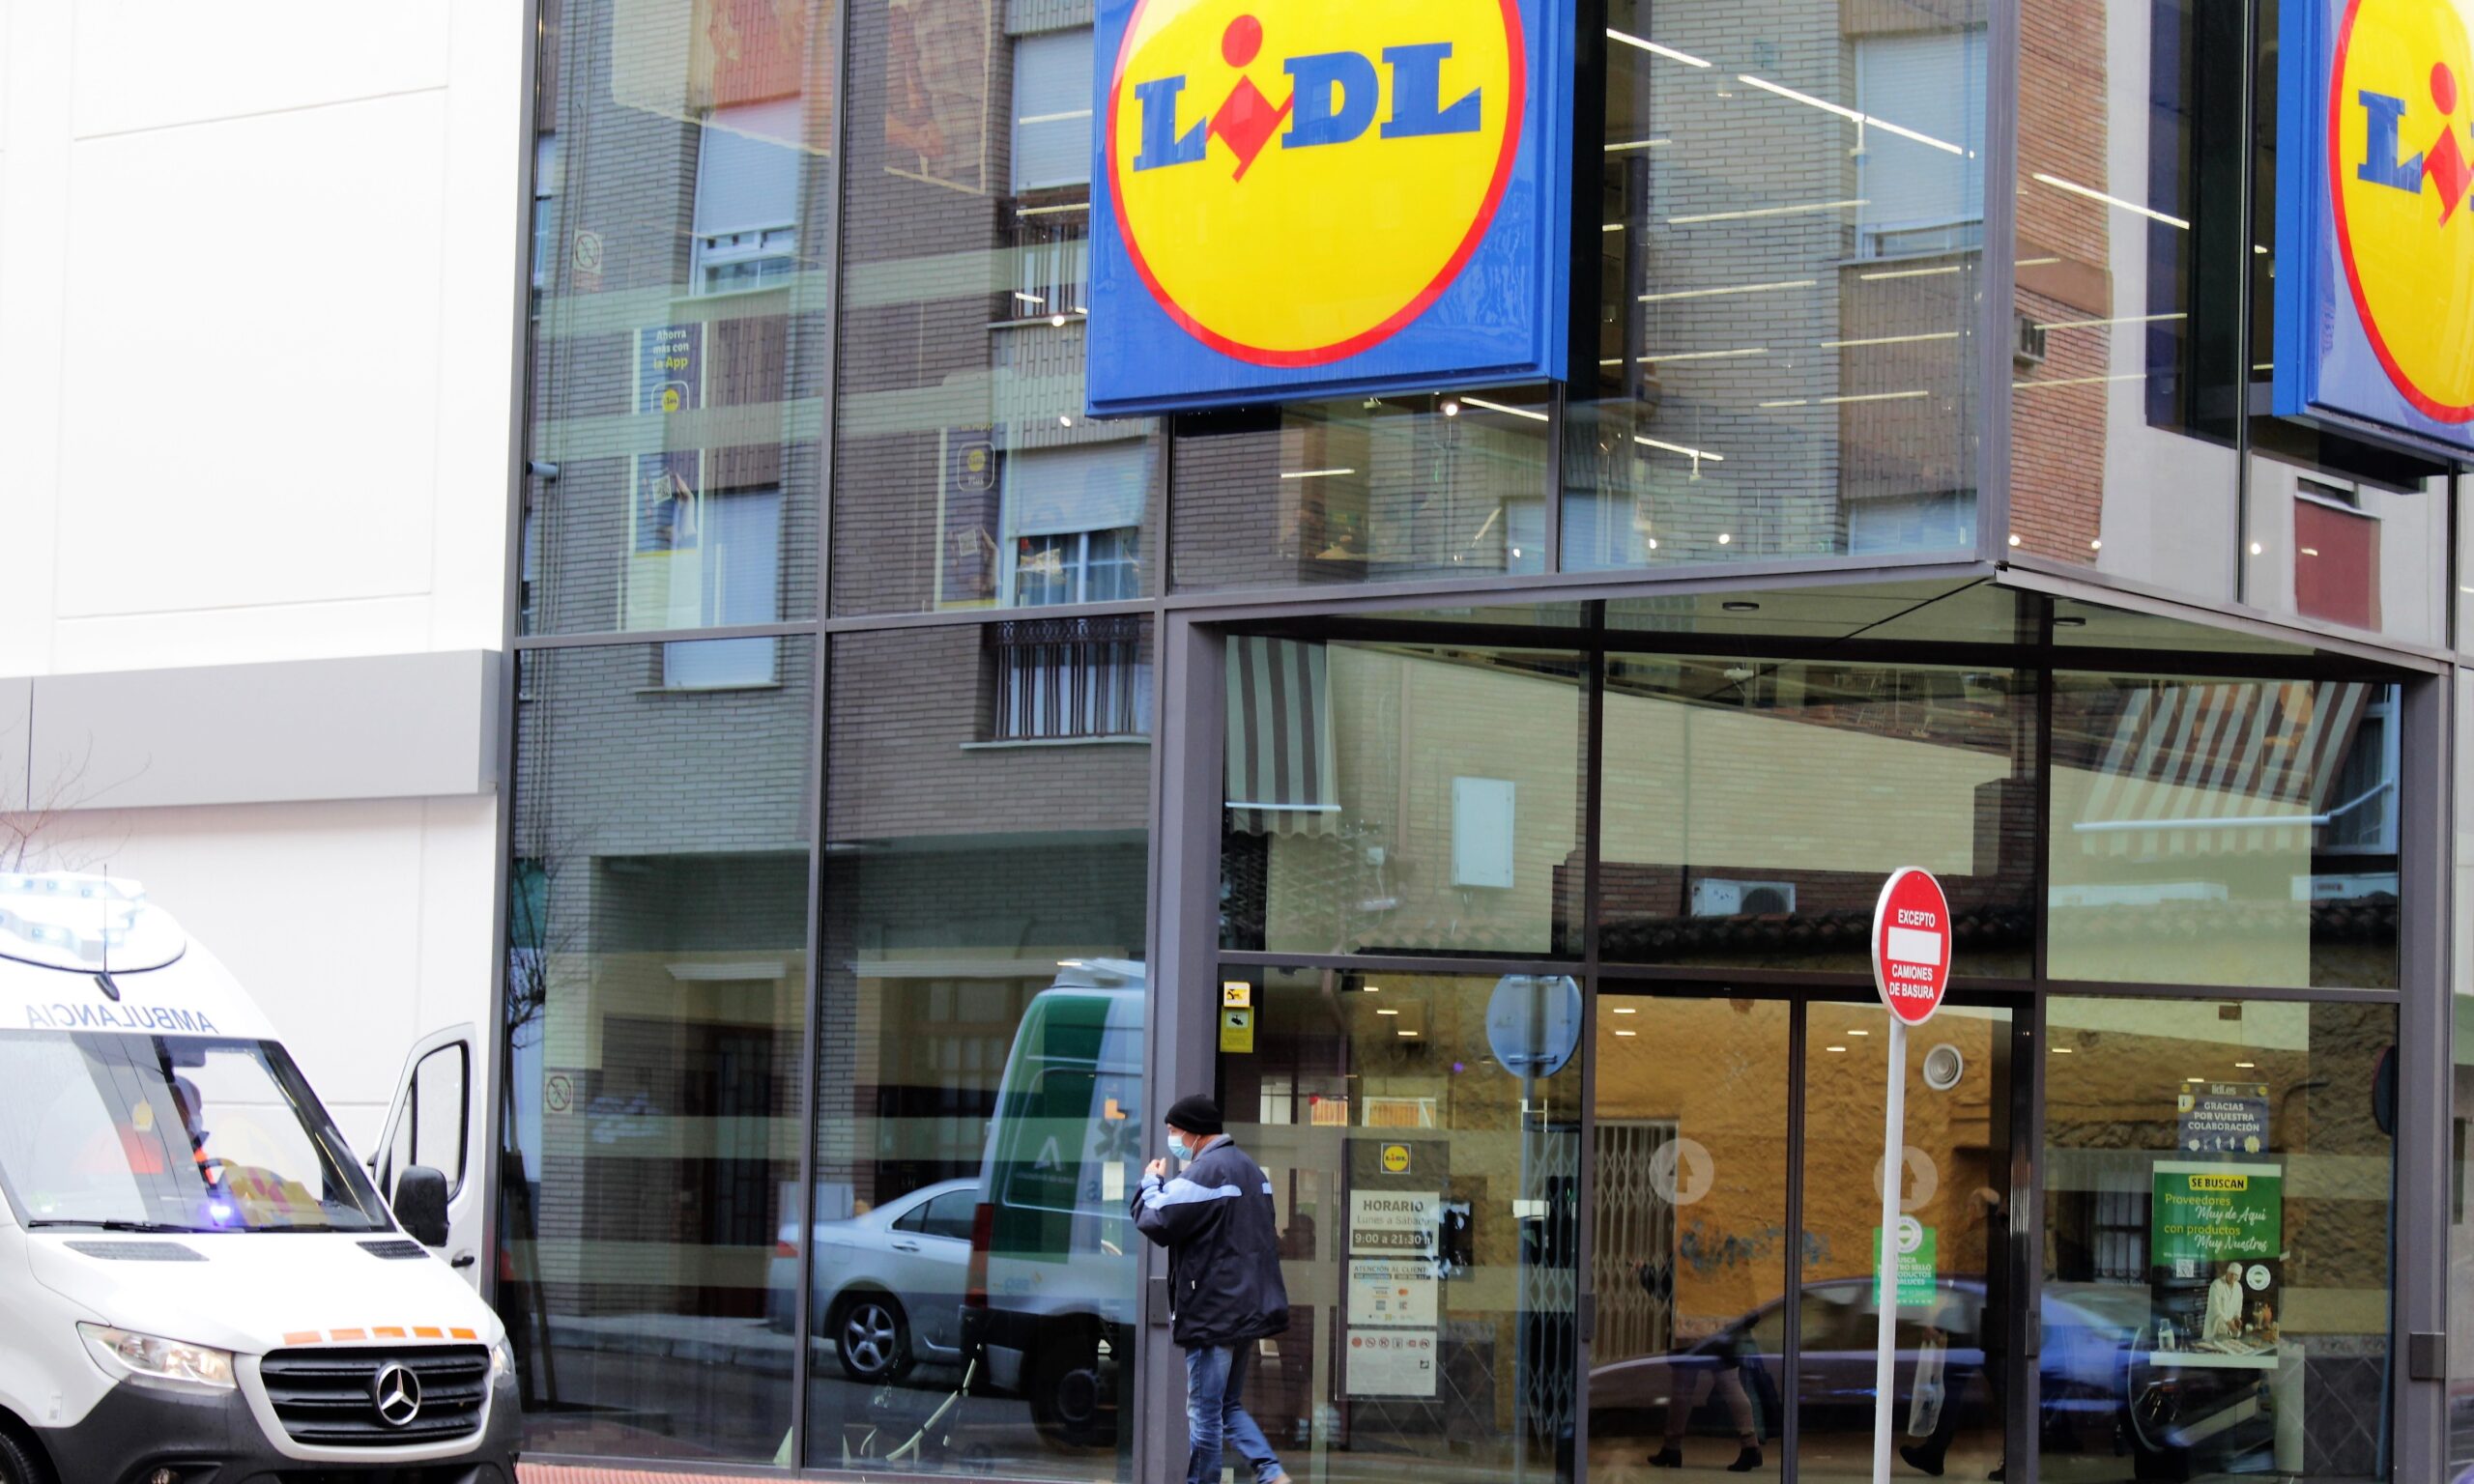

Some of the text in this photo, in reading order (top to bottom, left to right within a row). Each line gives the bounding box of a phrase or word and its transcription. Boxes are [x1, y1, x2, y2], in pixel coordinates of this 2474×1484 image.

[2357, 62, 2474, 228] LI
[656, 329, 687, 341] Ahorra
[672, 342, 689, 353] con
[665, 356, 688, 371] App
[1898, 908, 1936, 928] EXCEPTO
[1892, 964, 1933, 981] CAMIONES
[1889, 982, 1934, 1000] DE BASURA
[2204, 1101, 2244, 1111] GRACIAS
[2194, 1111, 2255, 1122] POR VUESTRA
[2188, 1121, 2259, 1131] COLABORACIÓN
[2192, 1178, 2244, 1189] SE BUSCAN
[2165, 1193, 2230, 1206] Proveedores
[1364, 1200, 1424, 1213] HORARIO
[1357, 1214, 1384, 1225] Lunes
[2195, 1205, 2224, 1225] Muy
[2225, 1206, 2237, 1220] de
[2164, 1223, 2241, 1236] con productos
[1355, 1233, 1379, 1244] 9:00
[1382, 1236, 1389, 1244] a
[1392, 1234, 1422, 1245] 21:30
[2194, 1235, 2269, 1254] Muy Nuestros
[1354, 1265, 1390, 1273] ATENCIÓN
